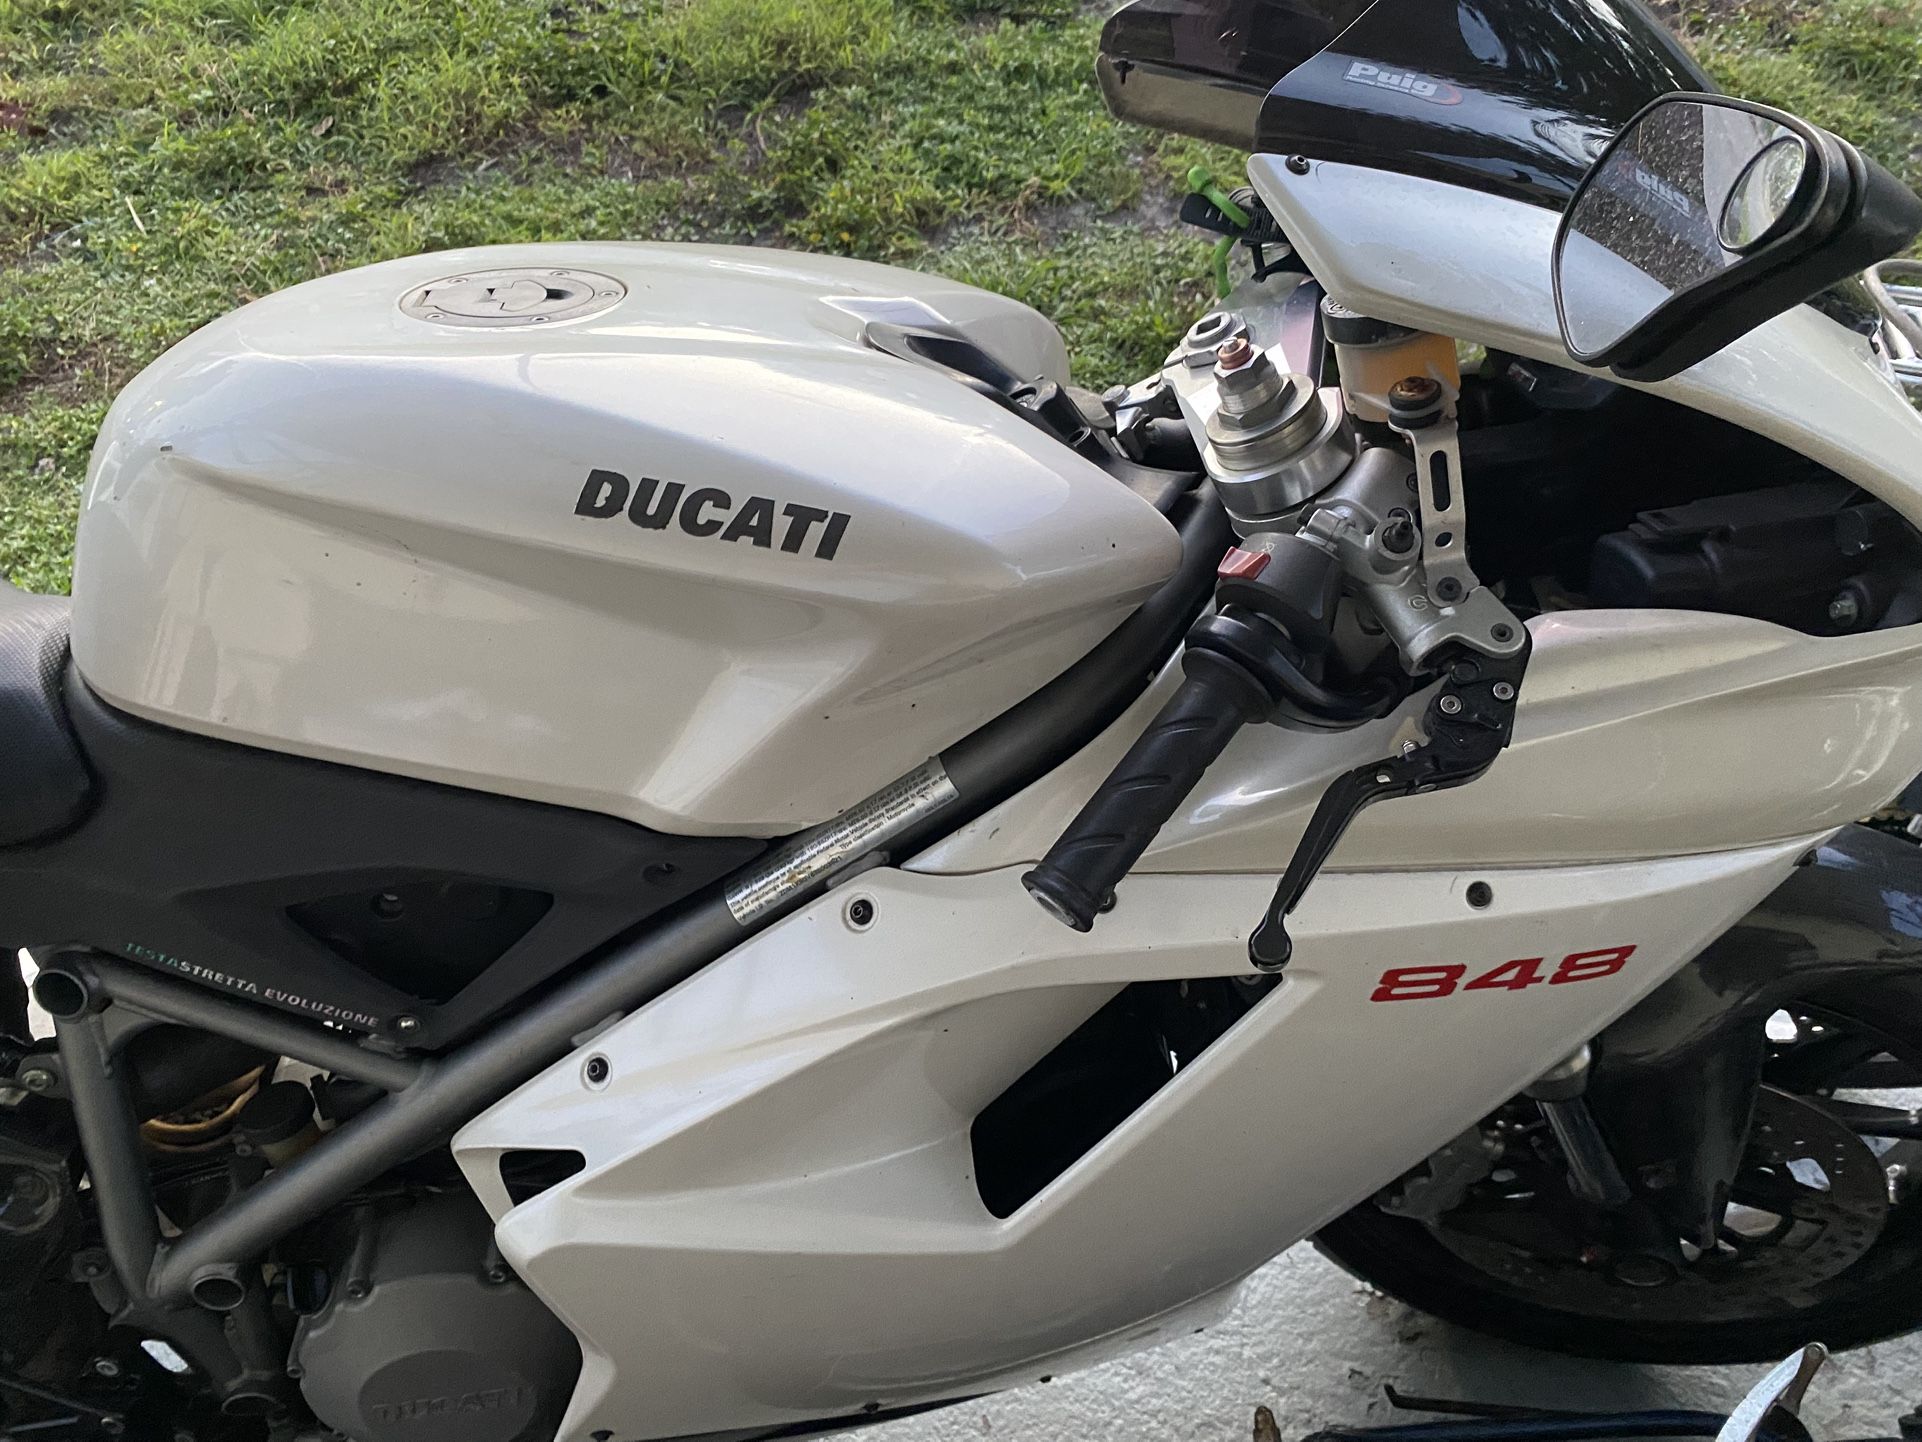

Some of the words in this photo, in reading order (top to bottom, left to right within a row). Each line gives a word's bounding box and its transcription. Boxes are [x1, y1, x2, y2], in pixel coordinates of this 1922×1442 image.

[1347, 61, 1438, 98] Puig
[574, 469, 851, 561] DUCATI
[125, 942, 258, 994] TESTASTRETTA
[265, 987, 380, 1027] EVOLUZIONE
[1370, 945, 1637, 1002] 848
